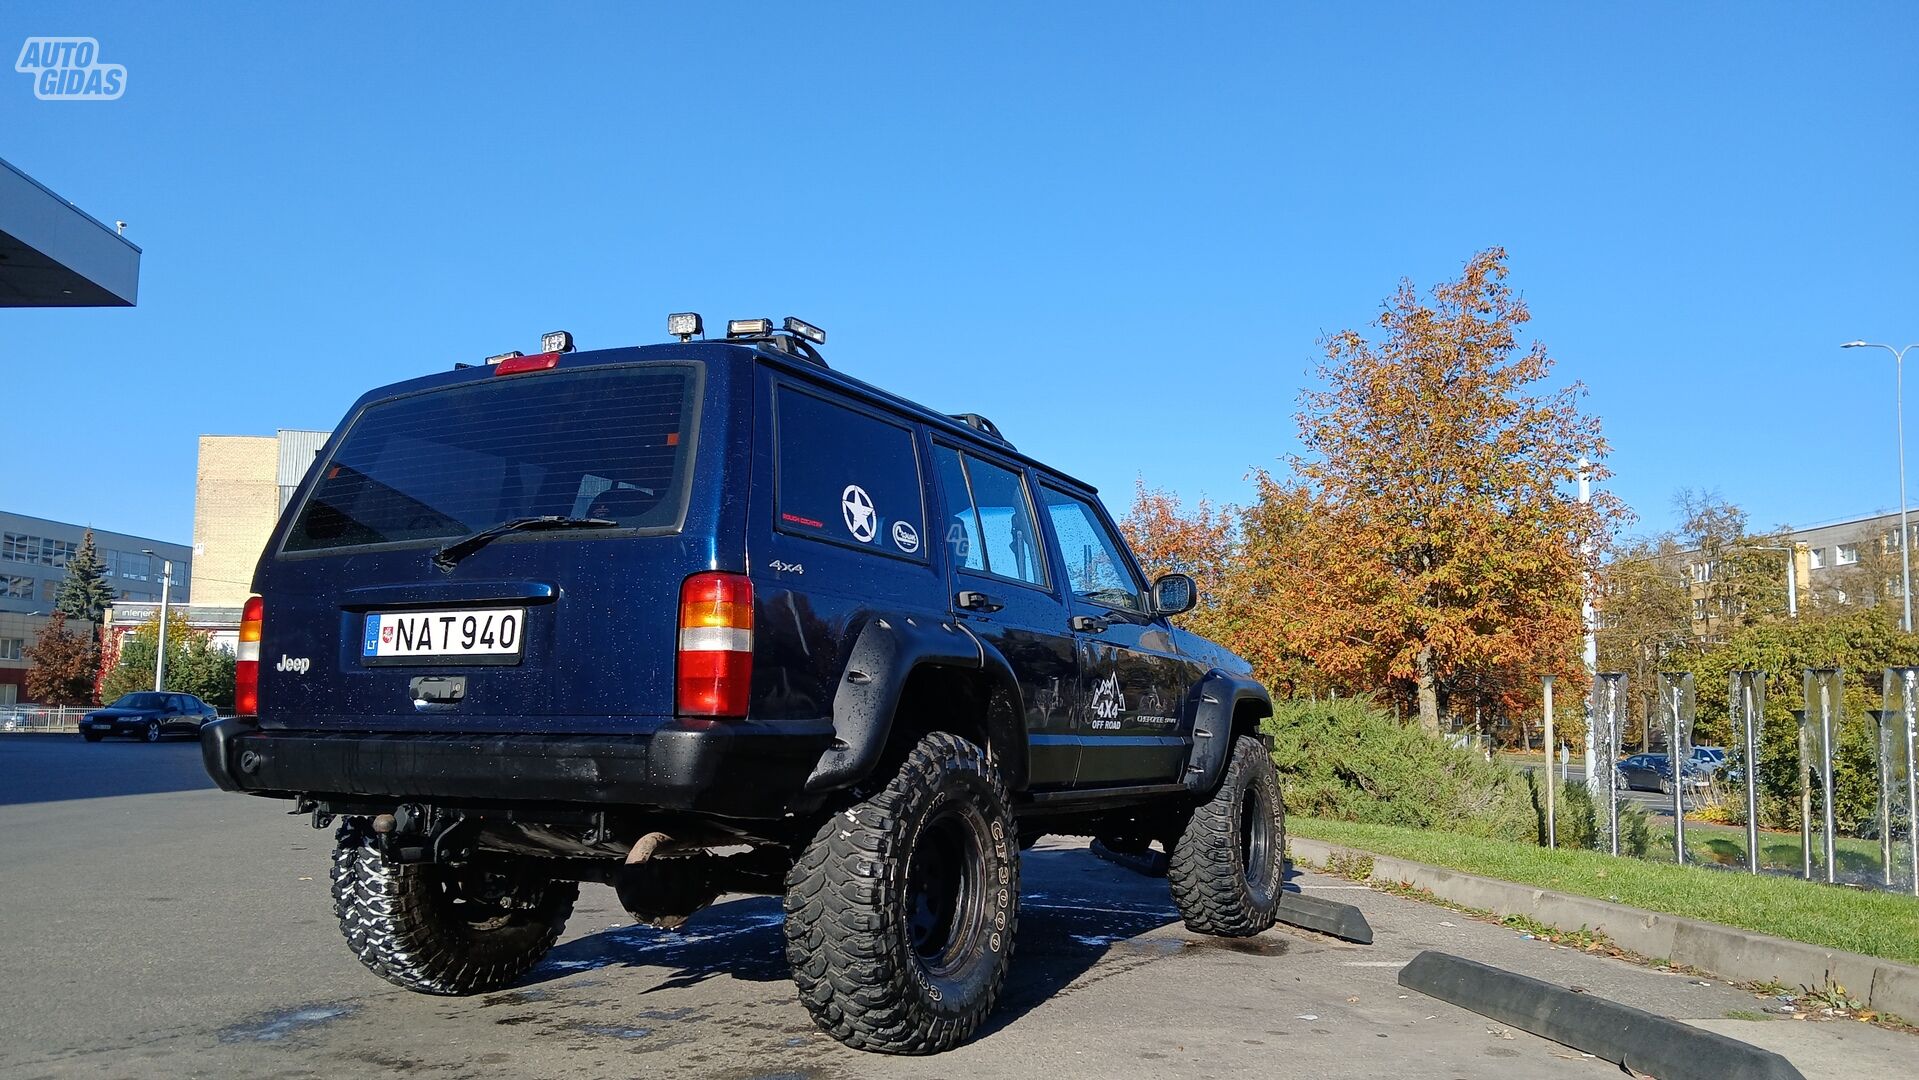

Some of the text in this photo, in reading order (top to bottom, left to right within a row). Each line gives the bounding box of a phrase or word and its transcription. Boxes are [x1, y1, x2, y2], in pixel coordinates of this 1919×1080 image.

[367, 640, 377, 650] LT
[276, 654, 310, 674] Jeep
[1092, 720, 1121, 730] OFF ROAD
[989, 820, 1009, 952] CF3000
